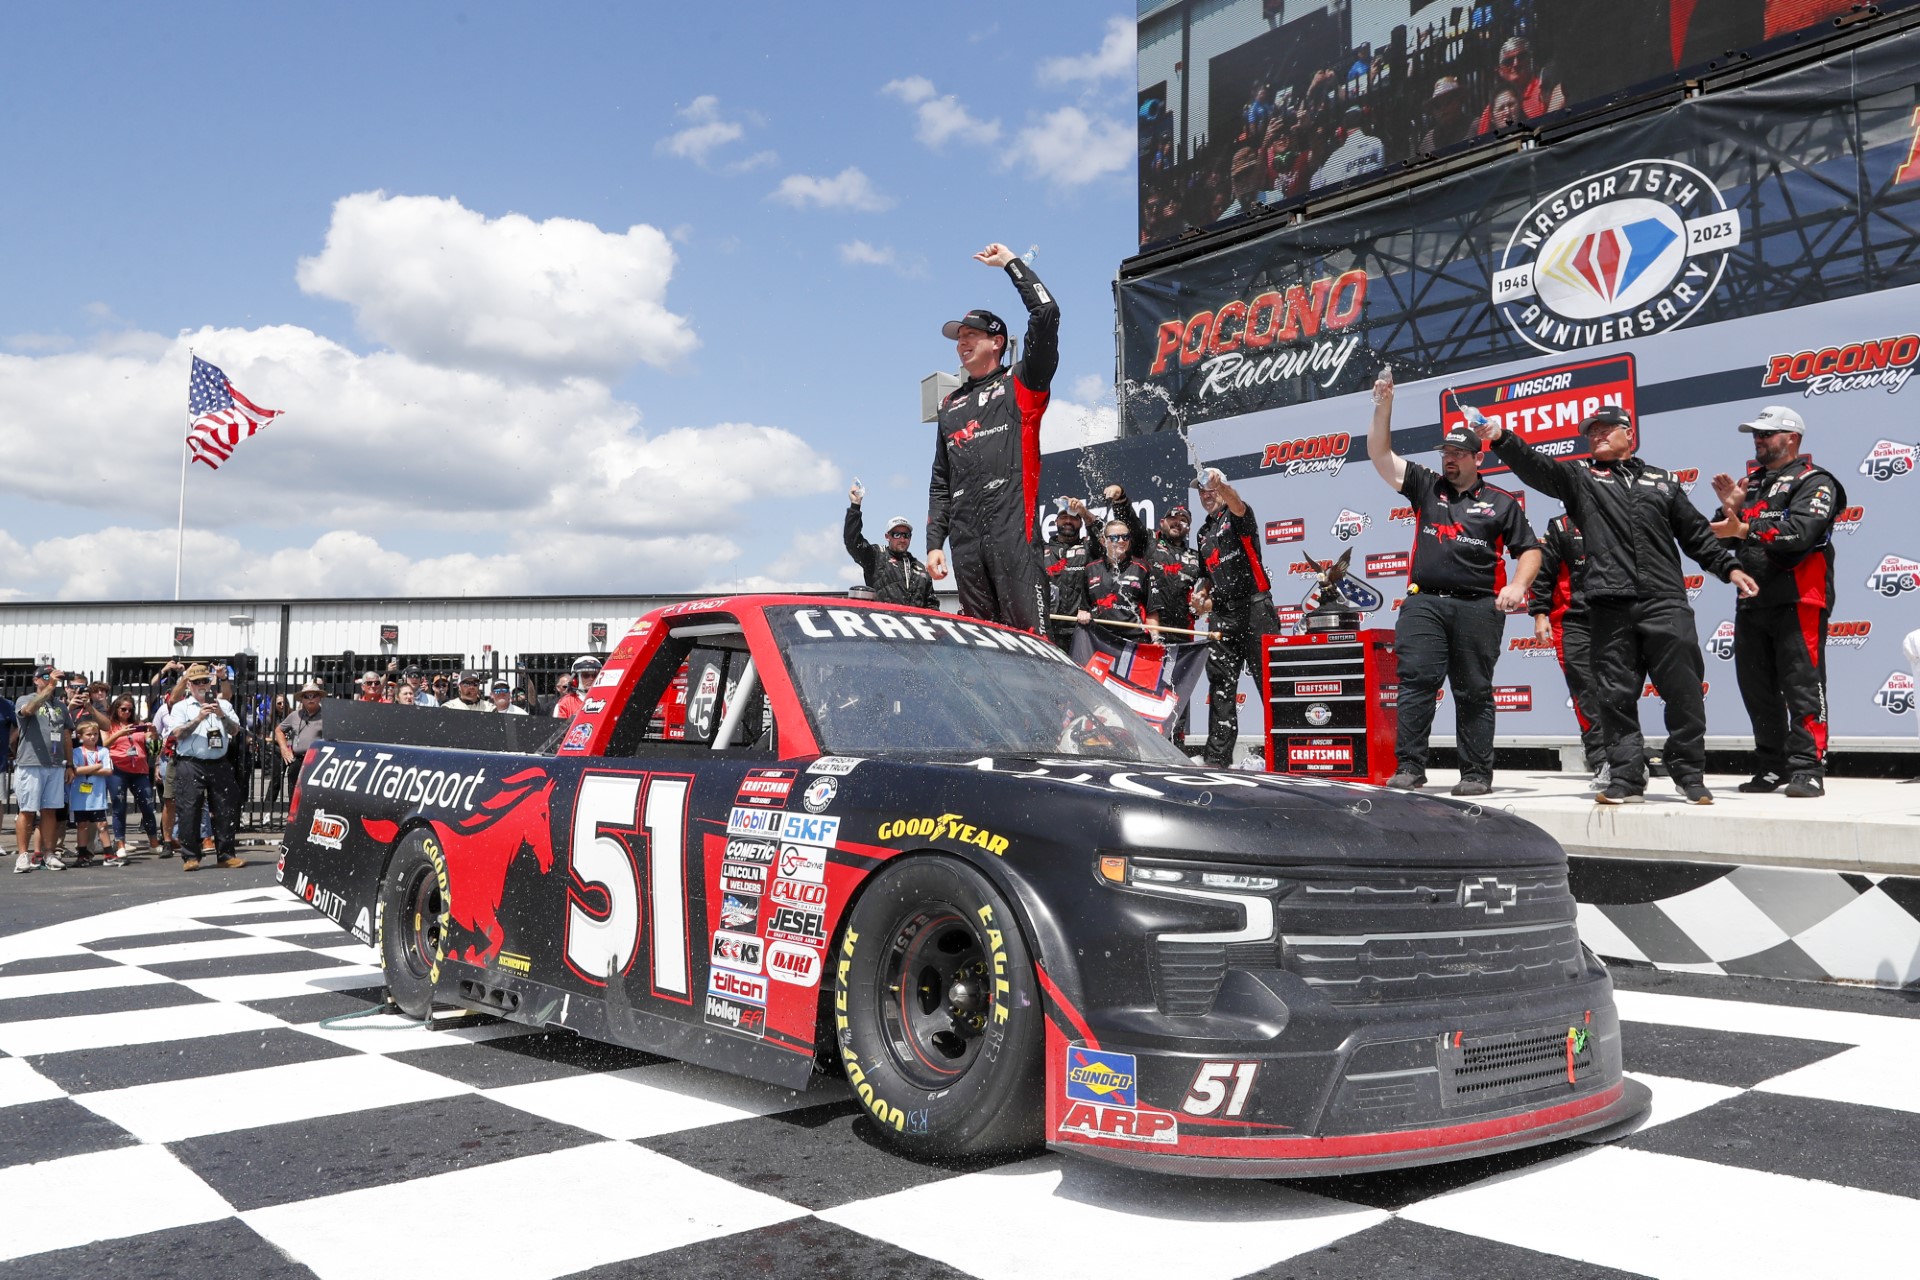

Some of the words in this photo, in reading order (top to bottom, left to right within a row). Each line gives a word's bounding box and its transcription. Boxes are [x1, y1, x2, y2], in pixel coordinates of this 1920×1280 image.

[1521, 176, 1616, 249] NASCAR
[1628, 169, 1699, 207] 75TH
[1693, 222, 1733, 243] 2023
[1498, 274, 1528, 292] 1948
[1520, 262, 1709, 346] ANNIVERSARY
[989, 321, 1001, 331] 51
[1151, 269, 1367, 375] POCONO
[1200, 337, 1359, 400] Raceway
[1764, 334, 1920, 386] POCONO
[1513, 372, 1572, 399] NASCAR
[1804, 367, 1914, 398] Raceway
[1262, 432, 1351, 467] POCONO
[1284, 457, 1346, 477] Raceway
[1267, 526, 1303, 537] CRAFTSMAN
[1368, 560, 1407, 570] CRAFTSMAN
[794, 609, 1084, 671] CRAFTSMAN
[1711, 638, 1736, 660] 15
[1297, 684, 1340, 693] CRAFTSMAN
[1291, 749, 1350, 760] CRAFTSMAN
[307, 746, 367, 792] Zariz
[365, 752, 485, 814] Transport
[742, 781, 790, 793] CRAFTSMAN
[311, 819, 342, 839] BALLEW
[731, 809, 768, 830] Mobil
[784, 817, 837, 841] SKF
[878, 814, 1010, 856] GOODYEAR
[726, 841, 775, 861] COMETIC
[723, 864, 760, 880] LINCOLN
[294, 872, 329, 915] Mobil
[566, 772, 690, 1000] 51
[729, 881, 761, 892] WELDERS
[773, 881, 827, 904] CALICO
[350, 926, 371, 945] AXALTA
[769, 908, 826, 937] JESEL
[713, 937, 760, 965] KOOKS
[978, 904, 1010, 1026] EAGLE
[713, 972, 763, 1000] tilton
[707, 997, 740, 1027] Holley
[836, 926, 905, 1131] GOODYEAR
[1071, 1069, 1132, 1089] SUNOCO
[1180, 1062, 1259, 1117] 51
[1064, 1104, 1175, 1137] ARP
